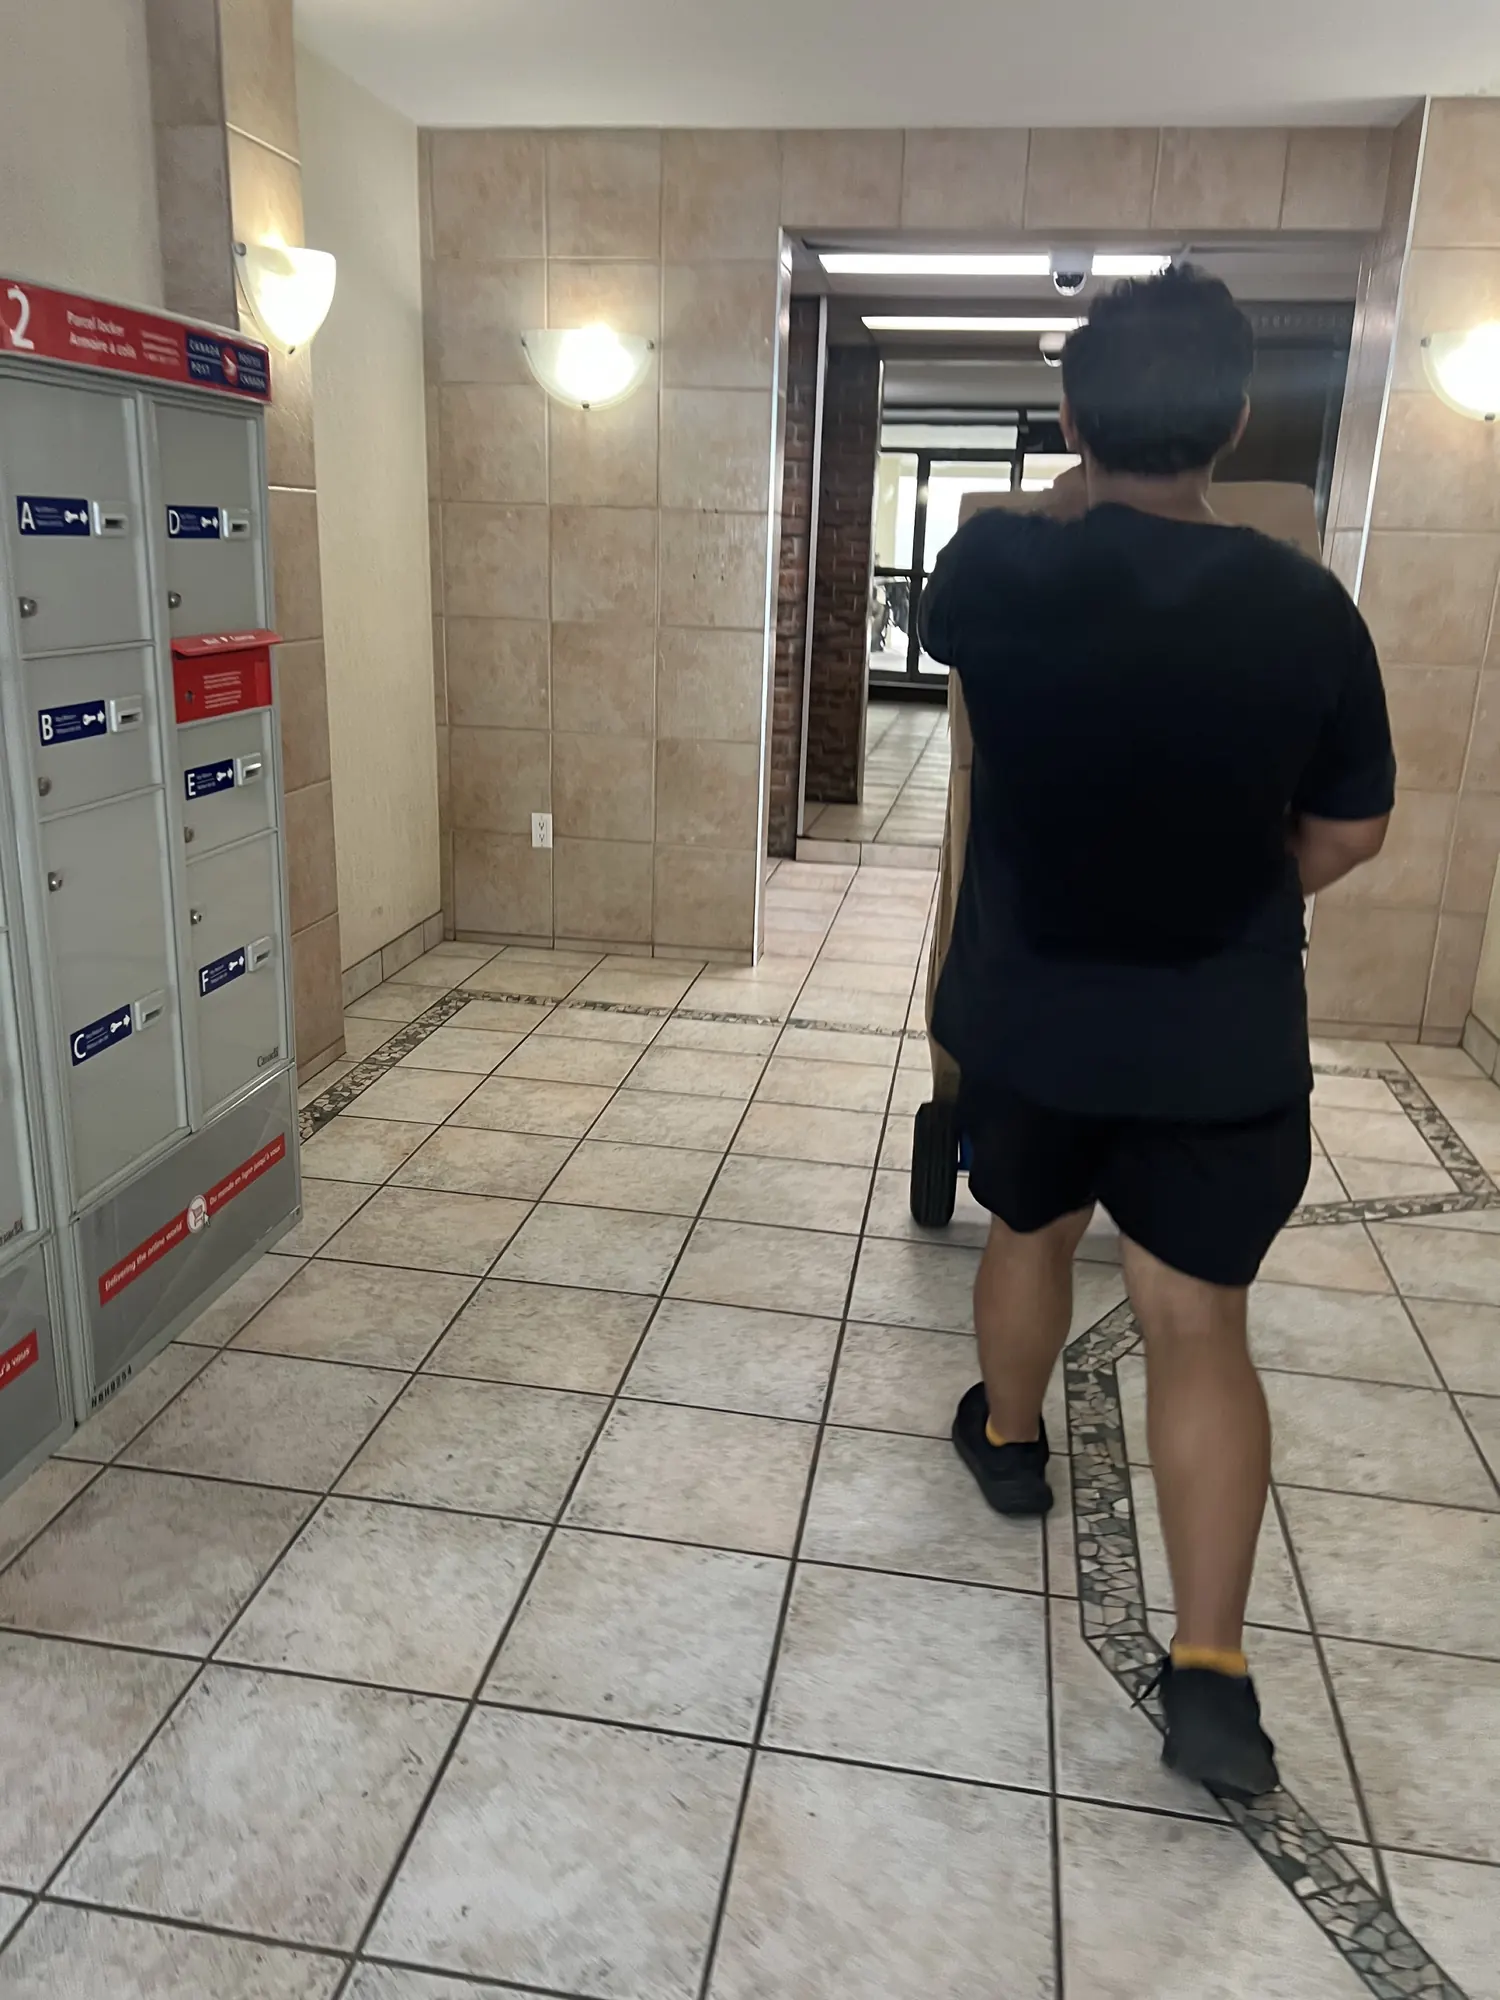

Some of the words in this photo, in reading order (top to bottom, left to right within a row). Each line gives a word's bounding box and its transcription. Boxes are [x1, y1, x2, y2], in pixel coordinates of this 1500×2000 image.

[7, 285, 35, 350] 2
[21, 501, 36, 530] A
[168, 509, 180, 535] D
[41, 714, 54, 741] B
[187, 773, 197, 797] E
[201, 969, 209, 992] F
[74, 1033, 87, 1059] C
[105, 1260, 136, 1292] Delivering
[136, 1252, 147, 1266] the
